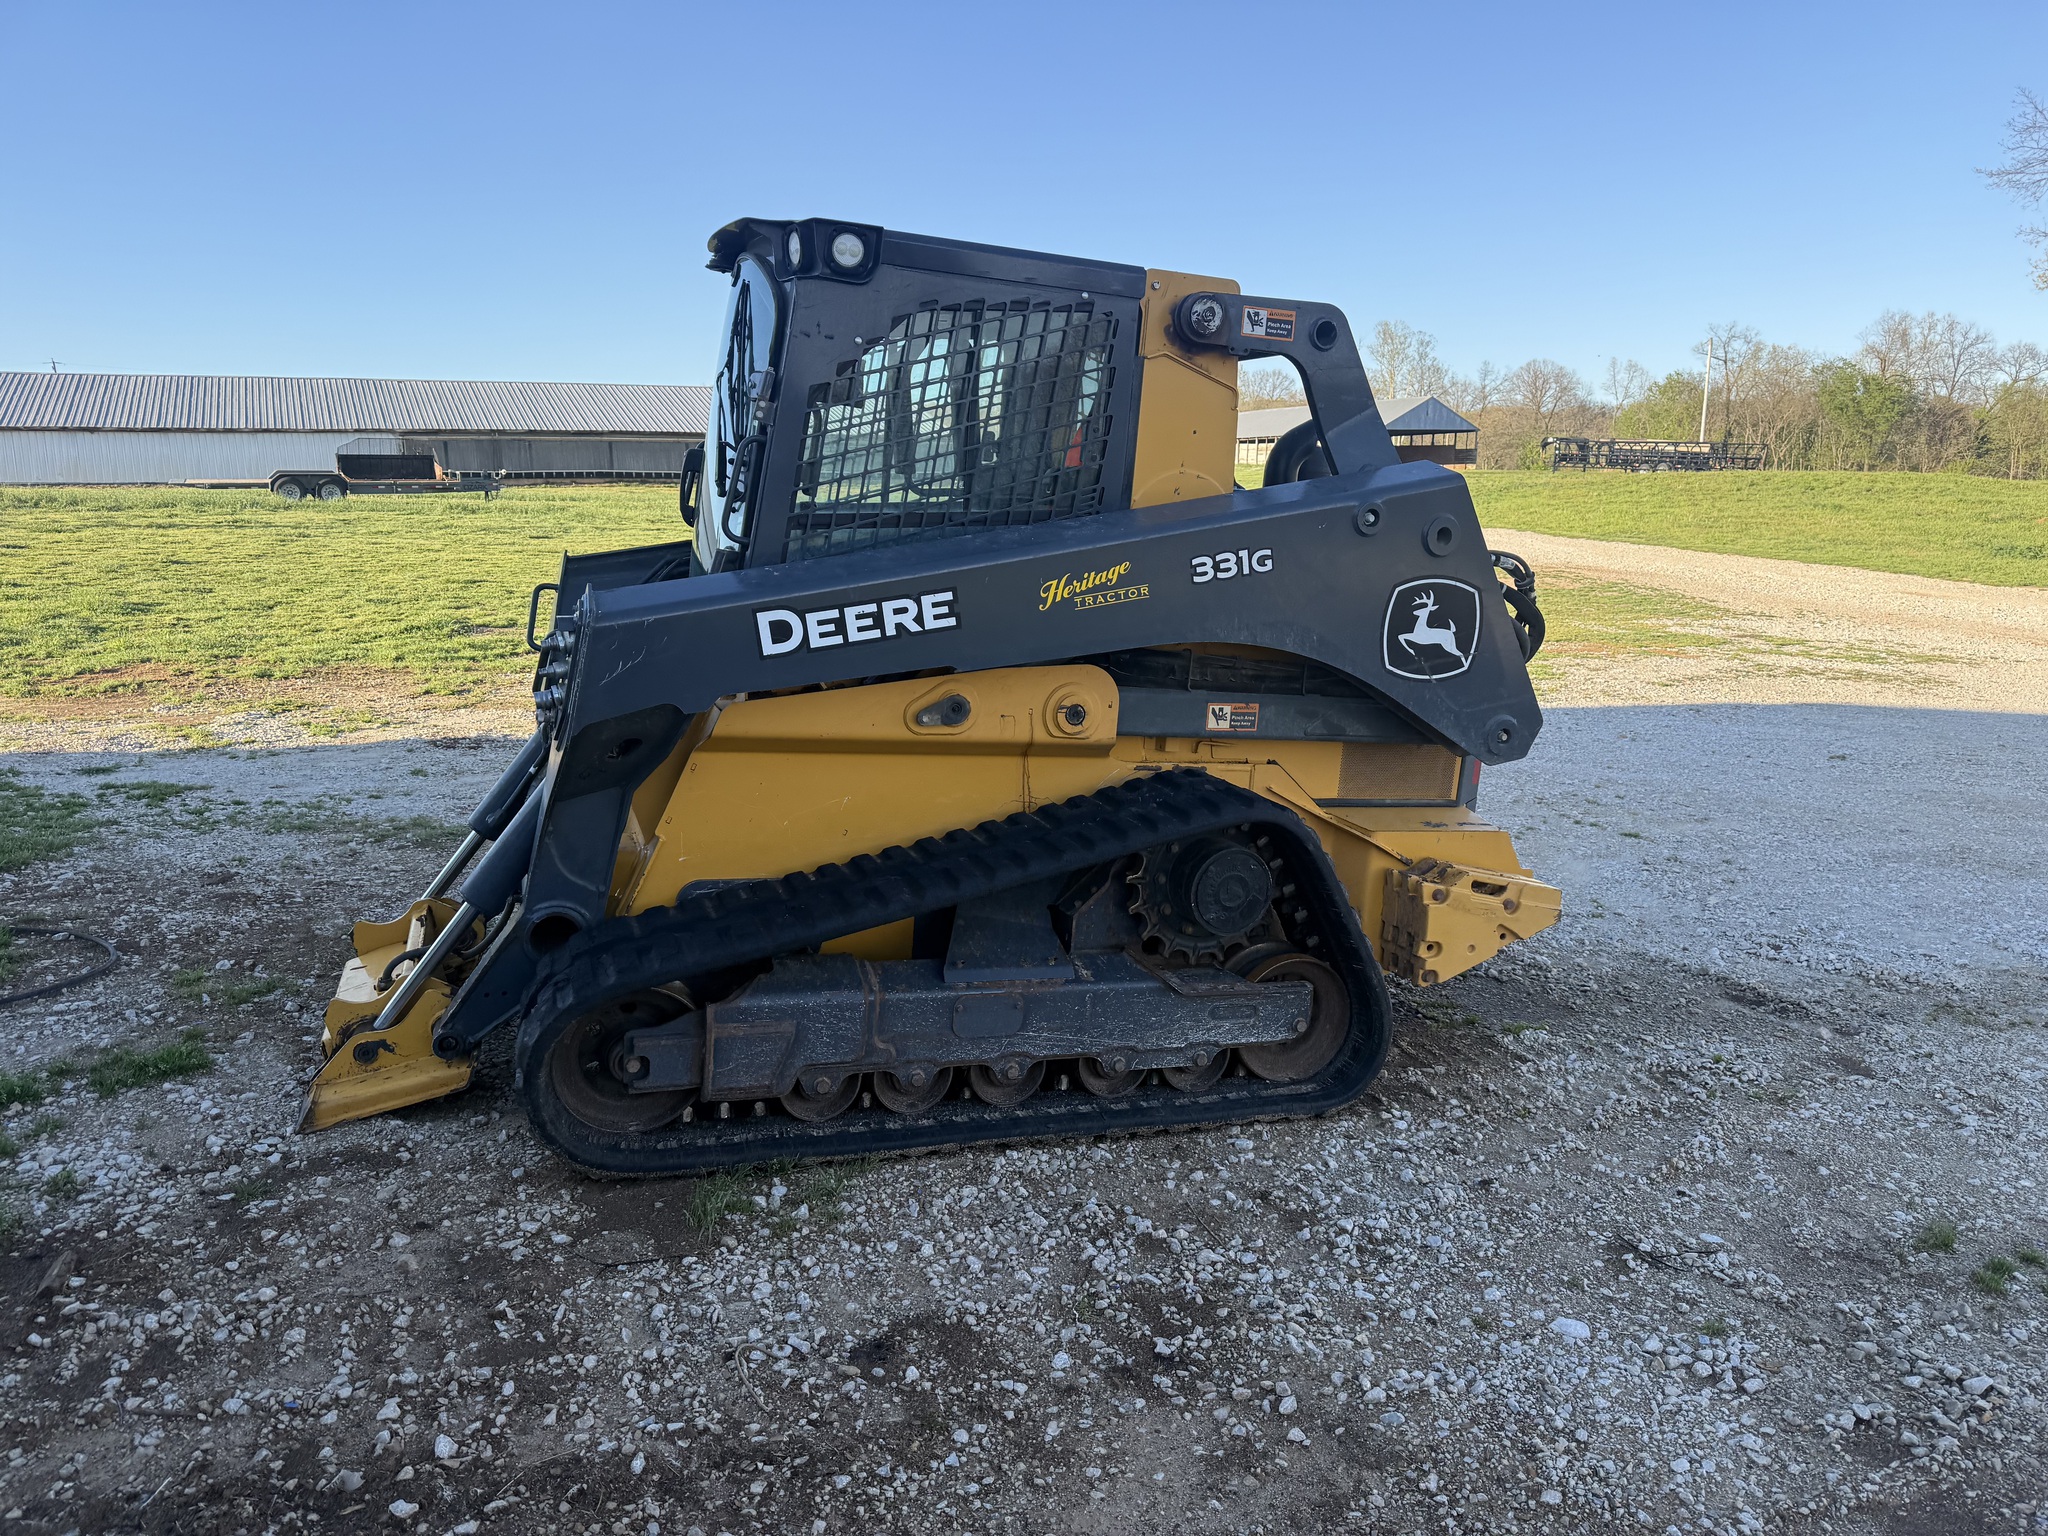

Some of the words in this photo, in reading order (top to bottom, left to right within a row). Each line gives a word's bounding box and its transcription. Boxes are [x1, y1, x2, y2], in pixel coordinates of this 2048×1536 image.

[1039, 561, 1131, 611] Heritage
[1191, 549, 1273, 583] 331G
[1074, 586, 1149, 607] TRACTOR
[756, 591, 957, 656] DEERE
